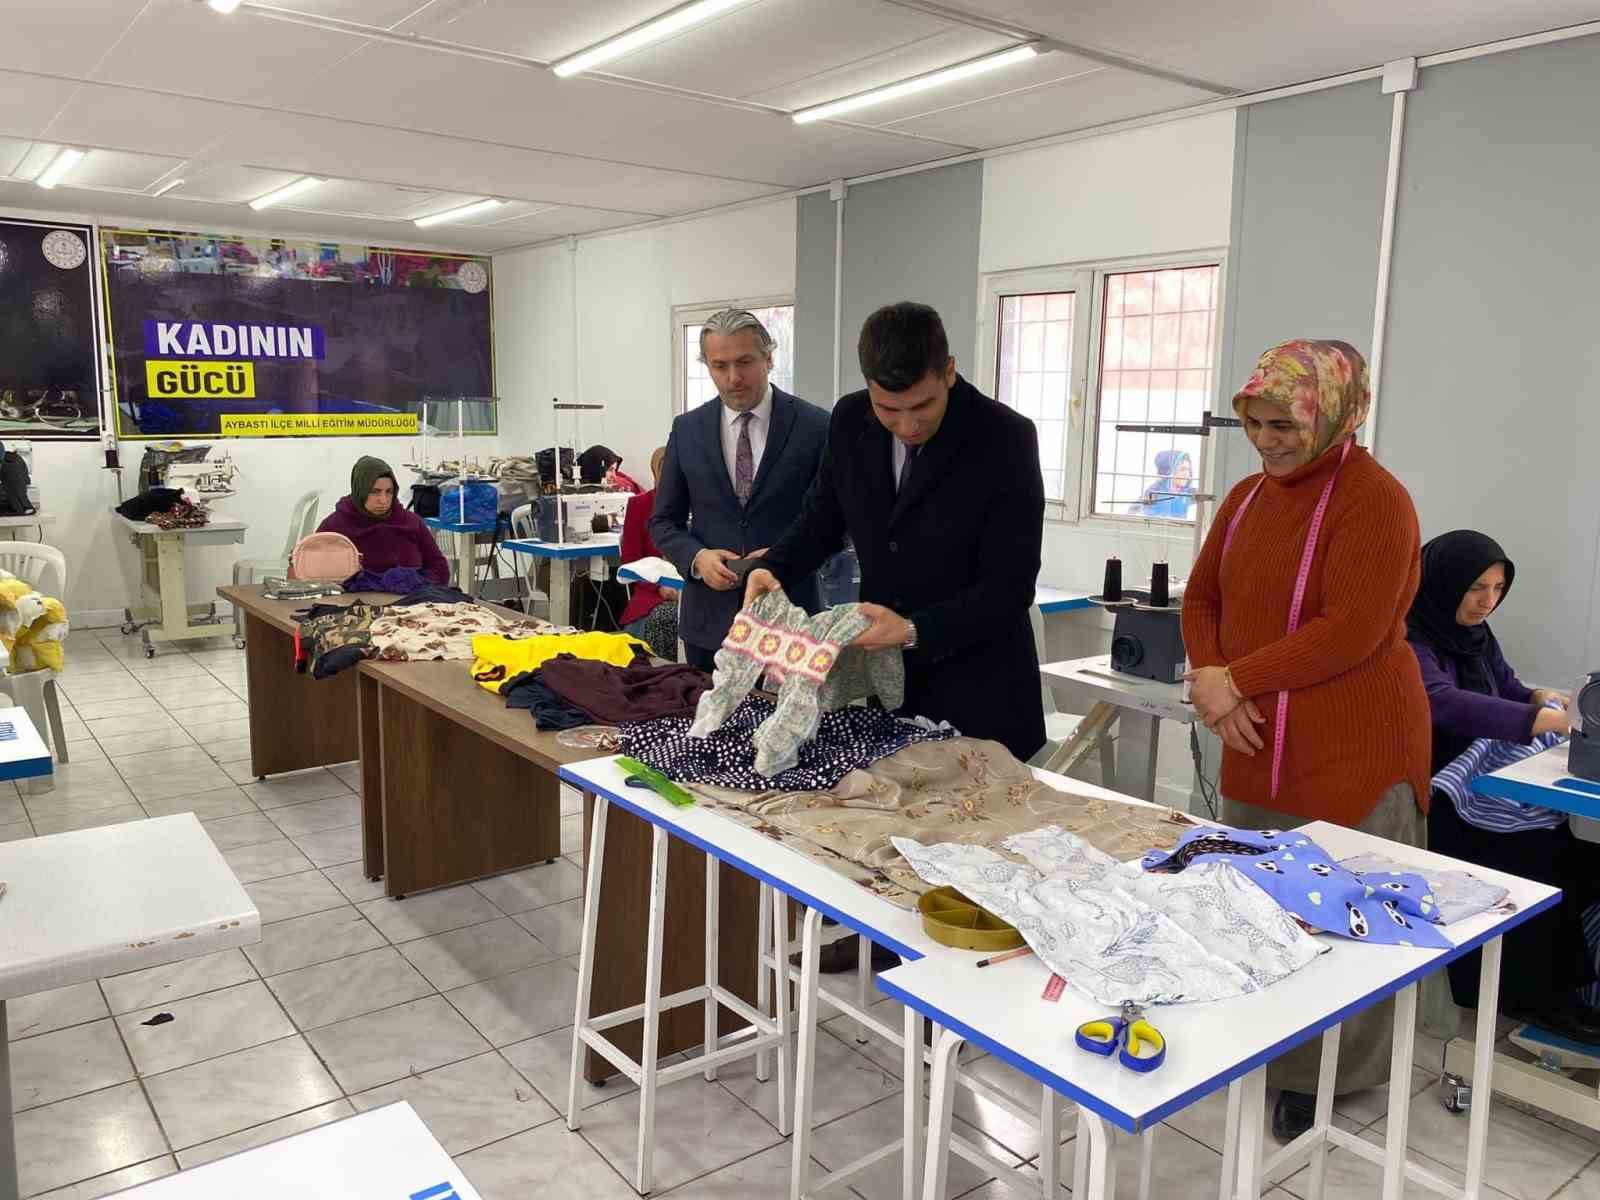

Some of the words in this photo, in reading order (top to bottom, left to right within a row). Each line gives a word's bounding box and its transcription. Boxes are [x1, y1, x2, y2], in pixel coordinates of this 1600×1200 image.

[157, 322, 313, 357] KADININ
[156, 364, 246, 394] GÜCÜ
[225, 419, 268, 429] AYBASTI
[270, 417, 294, 430] İLÇE
[357, 416, 416, 428] MÜDÜRLÜĞÜ
